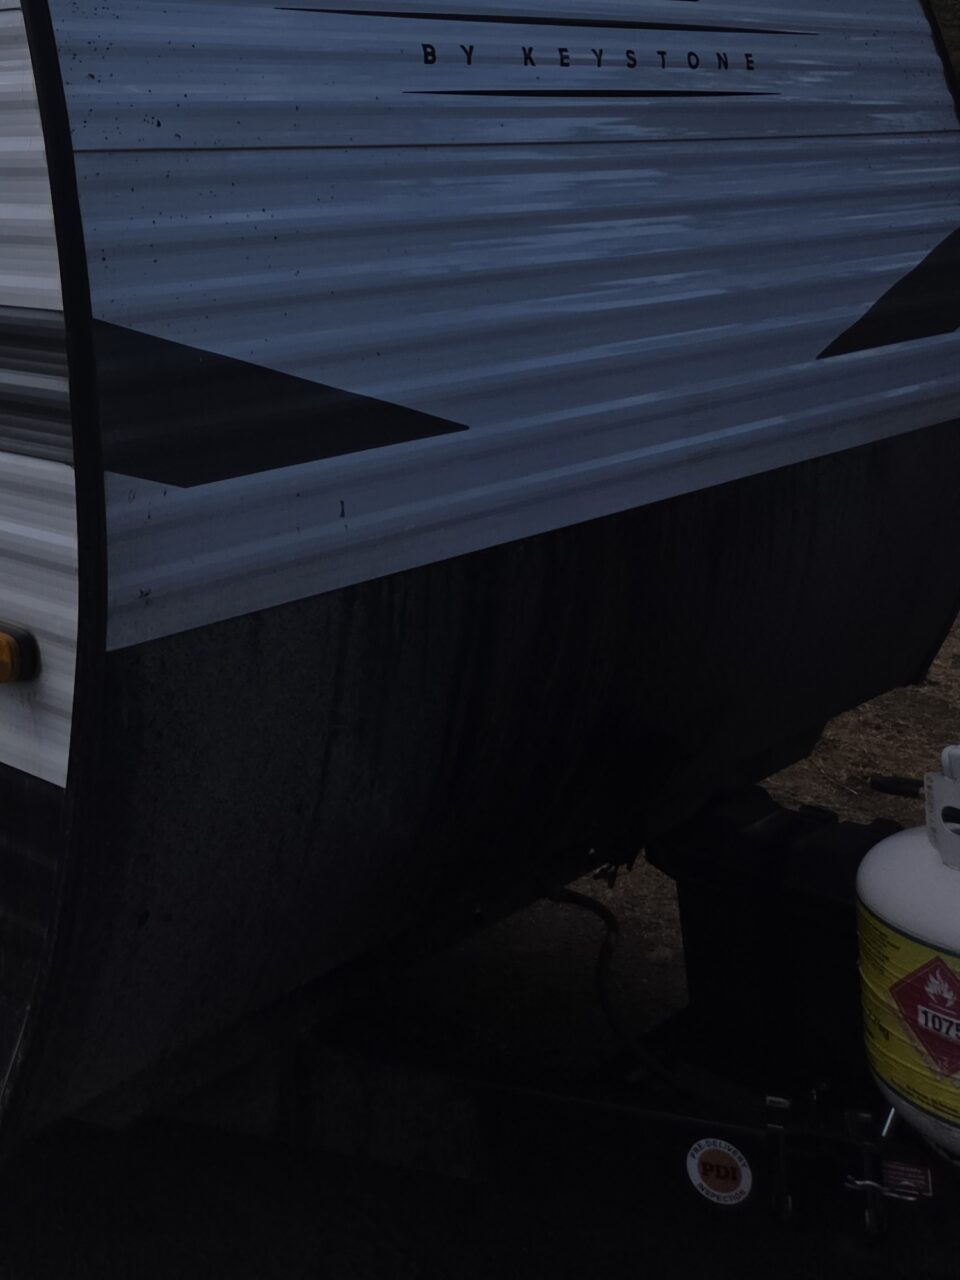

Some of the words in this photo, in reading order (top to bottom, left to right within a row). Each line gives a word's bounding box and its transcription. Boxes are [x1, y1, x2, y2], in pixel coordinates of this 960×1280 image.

[422, 43, 474, 65] BY
[521, 46, 755, 70] KEYSTONE
[701, 1161, 739, 1181] PDI
